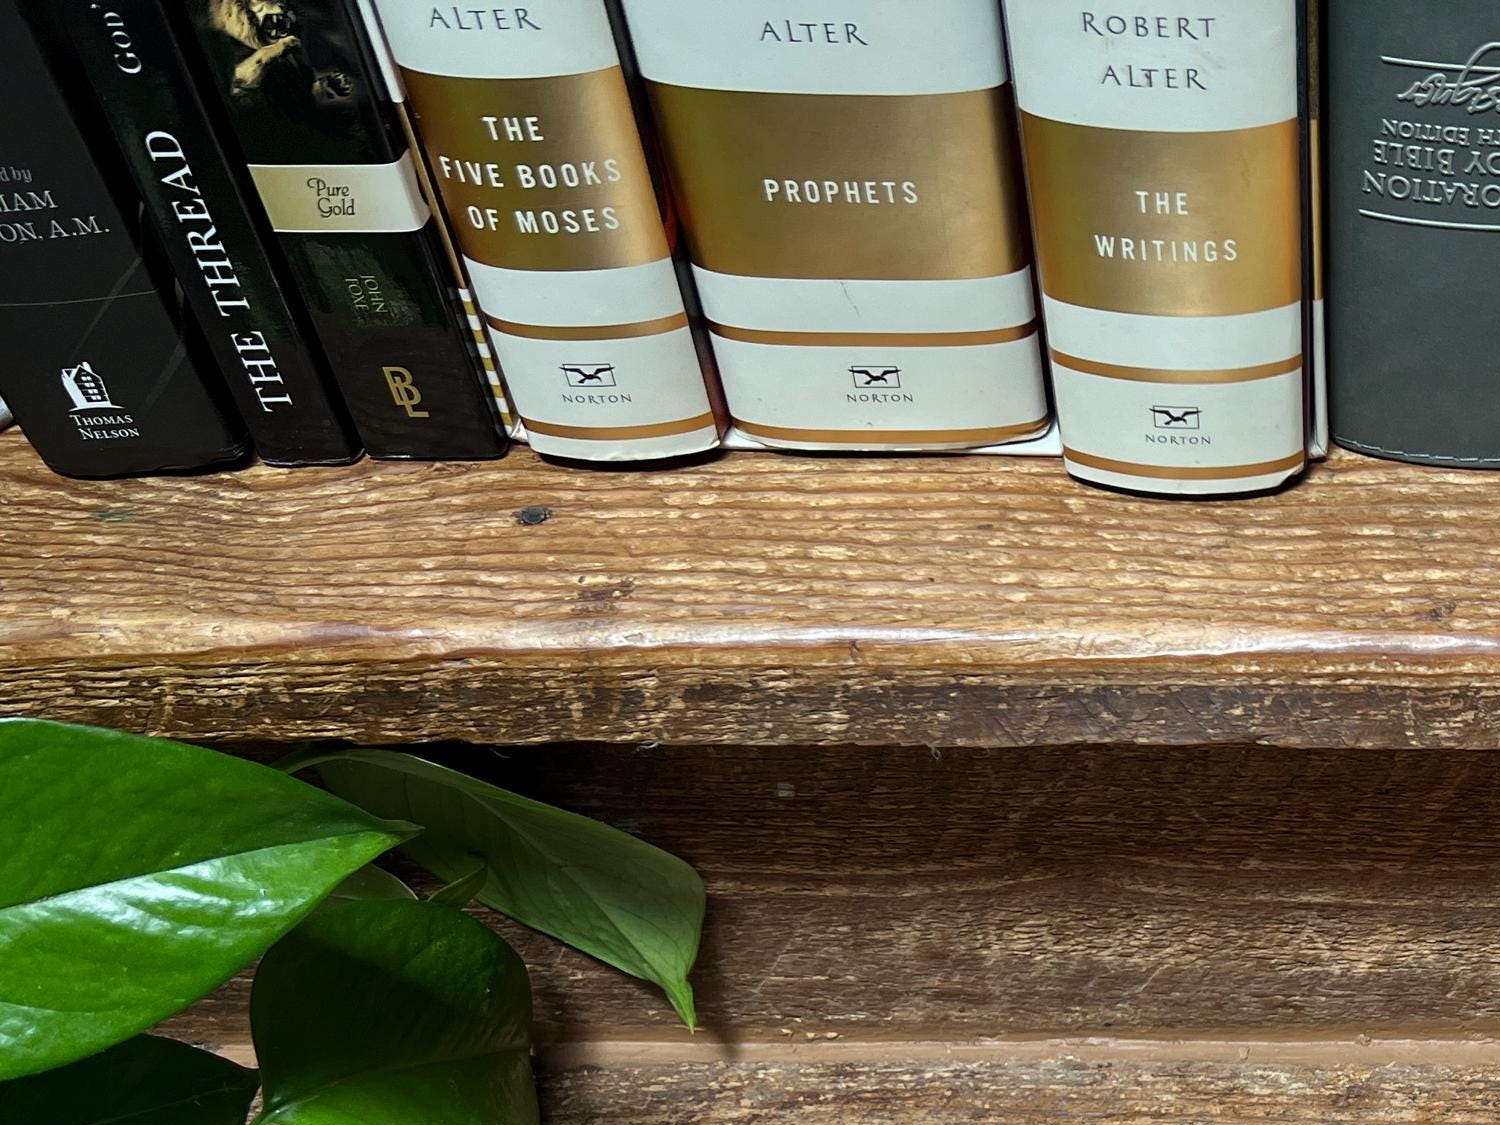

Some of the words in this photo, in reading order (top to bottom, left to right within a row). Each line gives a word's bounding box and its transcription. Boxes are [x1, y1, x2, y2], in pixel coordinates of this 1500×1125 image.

[430, 7, 542, 30] ALTER
[1082, 11, 1217, 39] ROBERT
[761, 20, 869, 46] ALTER
[1101, 65, 1207, 90] ALTER
[481, 116, 544, 142] THE
[1382, 118, 1470, 146] EDITION
[1373, 139, 1455, 175] BIBLE
[439, 155, 504, 188] FIVE
[517, 159, 622, 189] BOOKS
[306, 177, 350, 197] Pure
[763, 179, 918, 205] PROPHETS
[317, 197, 356, 218] Gold
[1136, 190, 1189, 216] THE
[145, 131, 250, 317] THREAD
[467, 205, 499, 232] OF
[515, 207, 621, 235] MOSES
[1095, 234, 1239, 262] WRITINGS
[231, 331, 293, 412] THE
[561, 393, 633, 405] NORTON
[847, 393, 914, 403] NORTON
[68, 414, 134, 427] THOMAS
[78, 427, 140, 440] NELSON
[1145, 434, 1212, 446] NORTON
